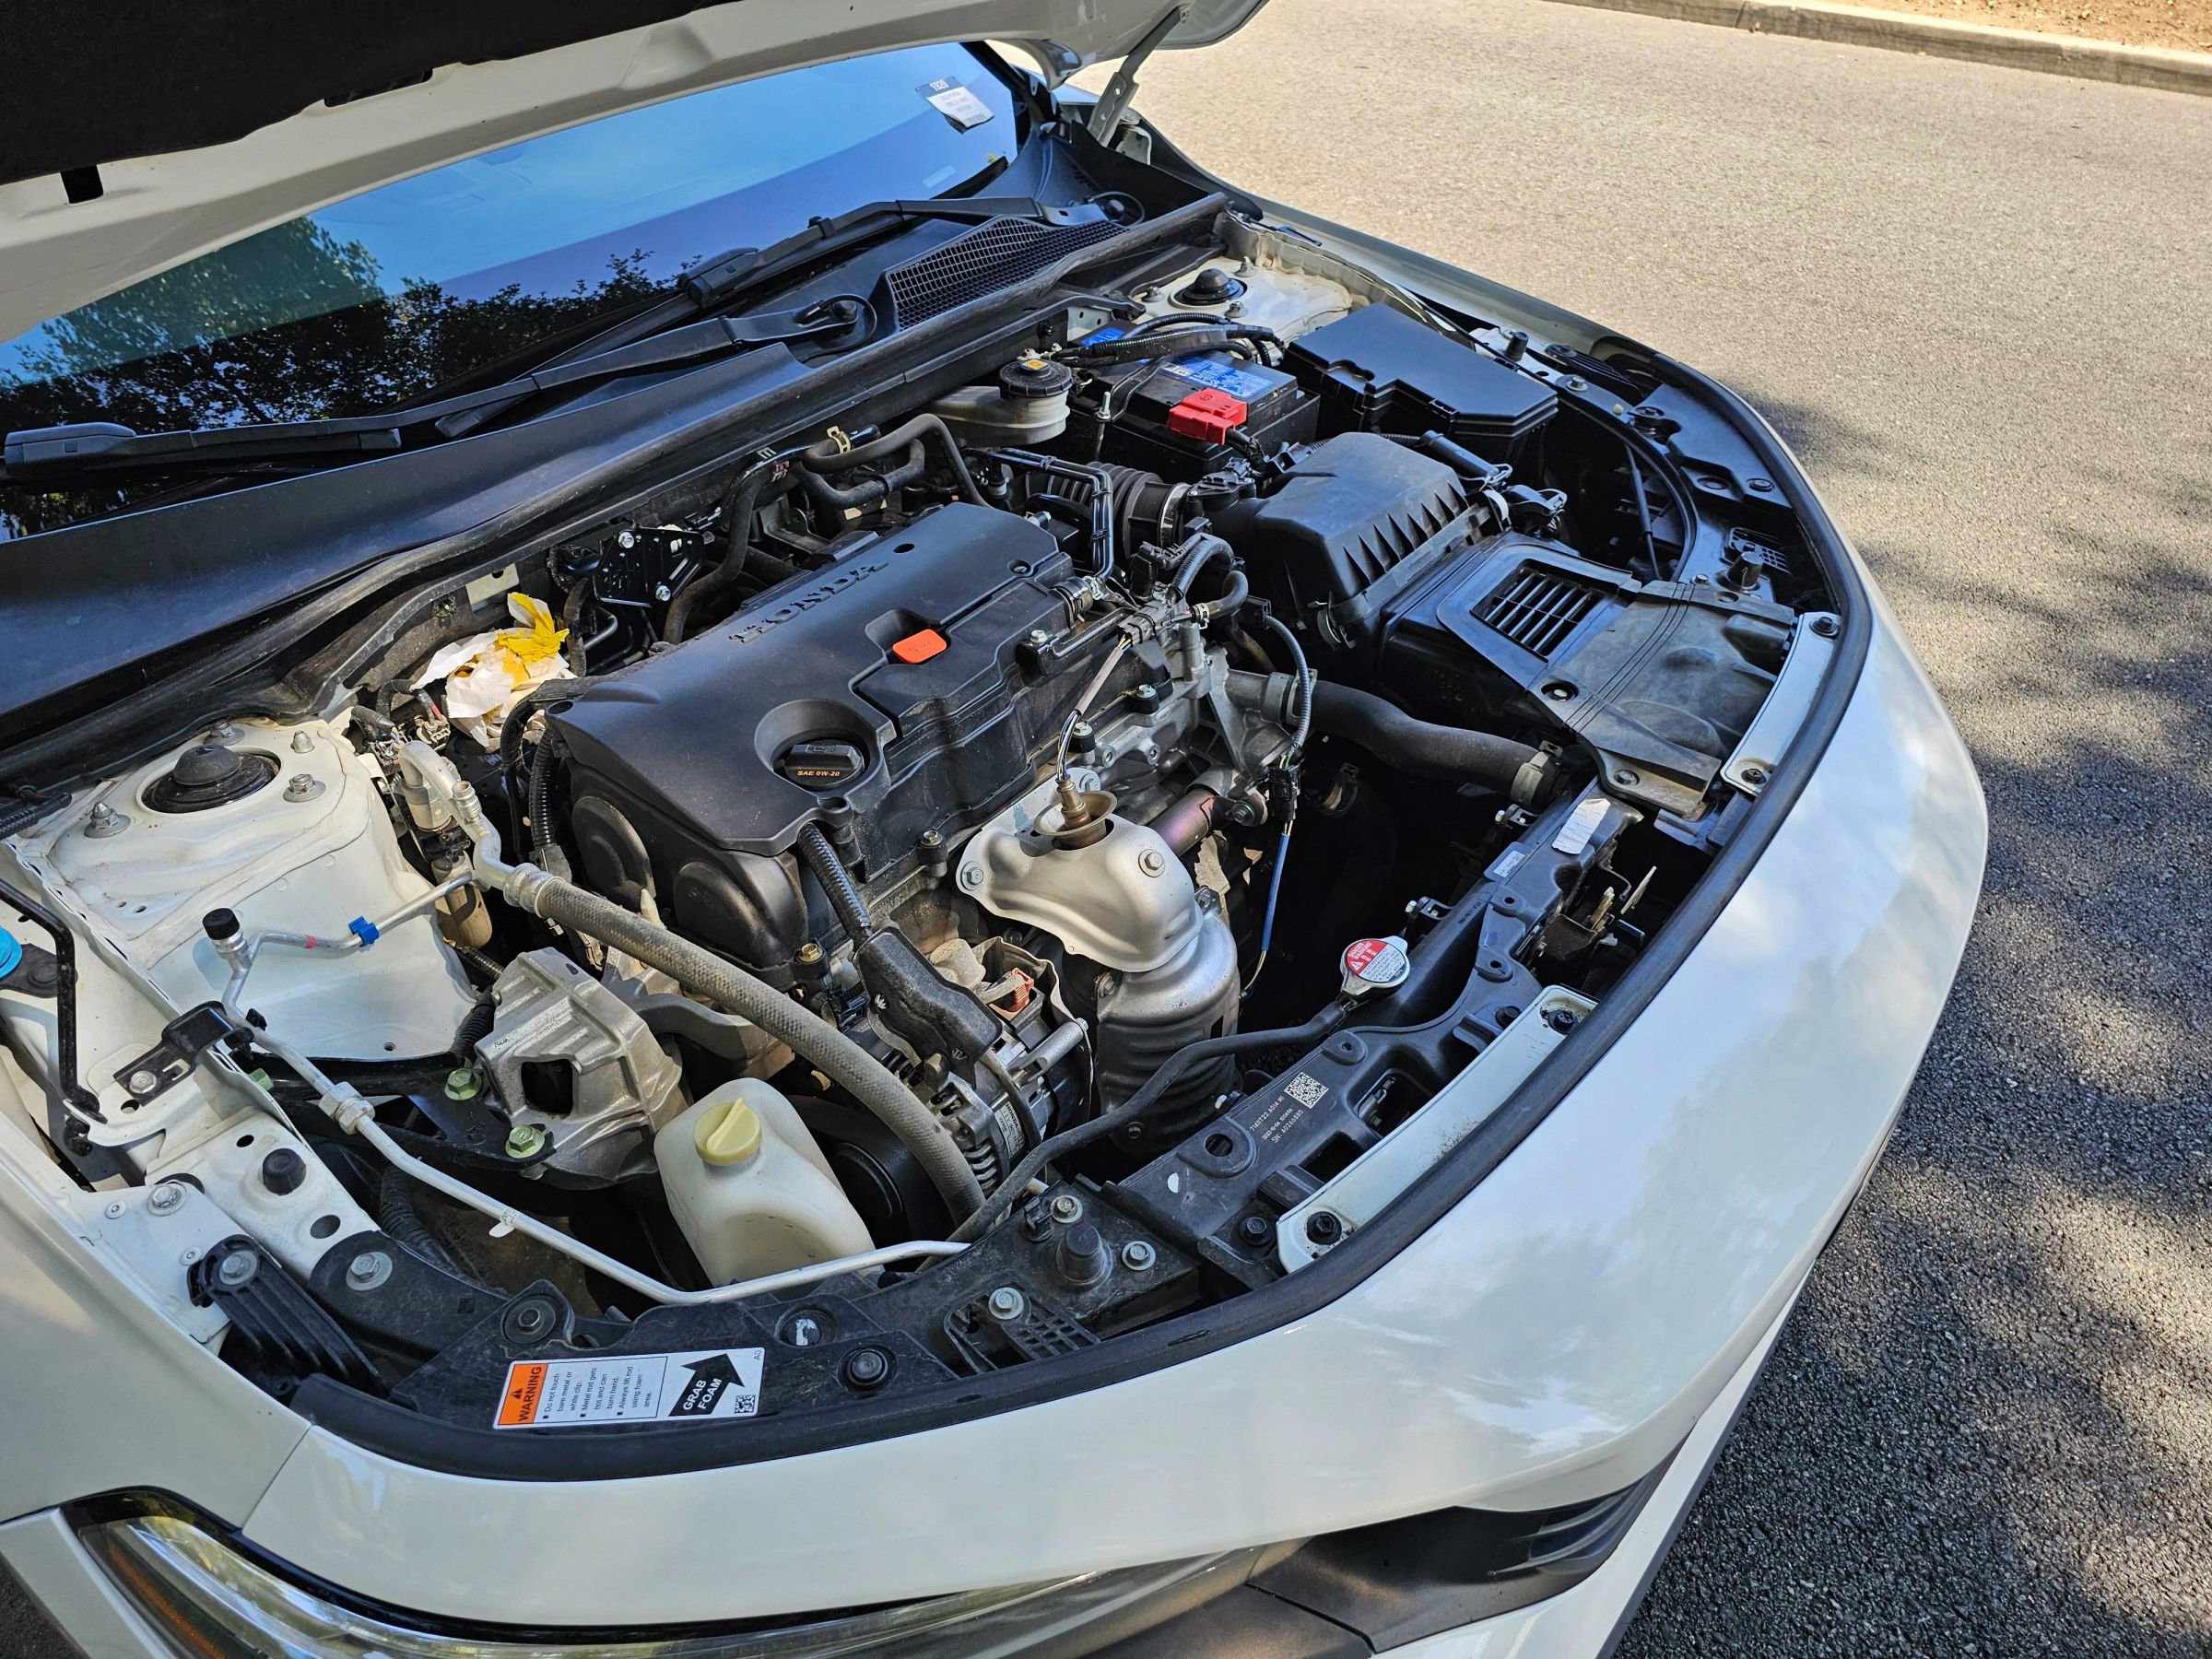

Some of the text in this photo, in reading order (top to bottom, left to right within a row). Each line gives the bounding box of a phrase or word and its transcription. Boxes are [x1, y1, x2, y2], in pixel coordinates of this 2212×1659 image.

[728, 561, 889, 644] HONDA
[1006, 1103, 1018, 1128] HONDA
[518, 1367, 542, 1421] WARNING
[544, 1403, 553, 1413] Do
[550, 1373, 560, 1392] touch
[557, 1397, 566, 1412] bare
[562, 1379, 571, 1396] metal
[571, 1381, 582, 1411] white clip.
[582, 1394, 591, 1410] Metal
[594, 1400, 602, 1410] hot
[606, 1377, 619, 1409] burn hand.
[619, 1386, 629, 1409] Always
[631, 1373, 643, 1408] using foam
[683, 1380, 707, 1410] GRAB
[697, 1378, 723, 1409] FOAM
